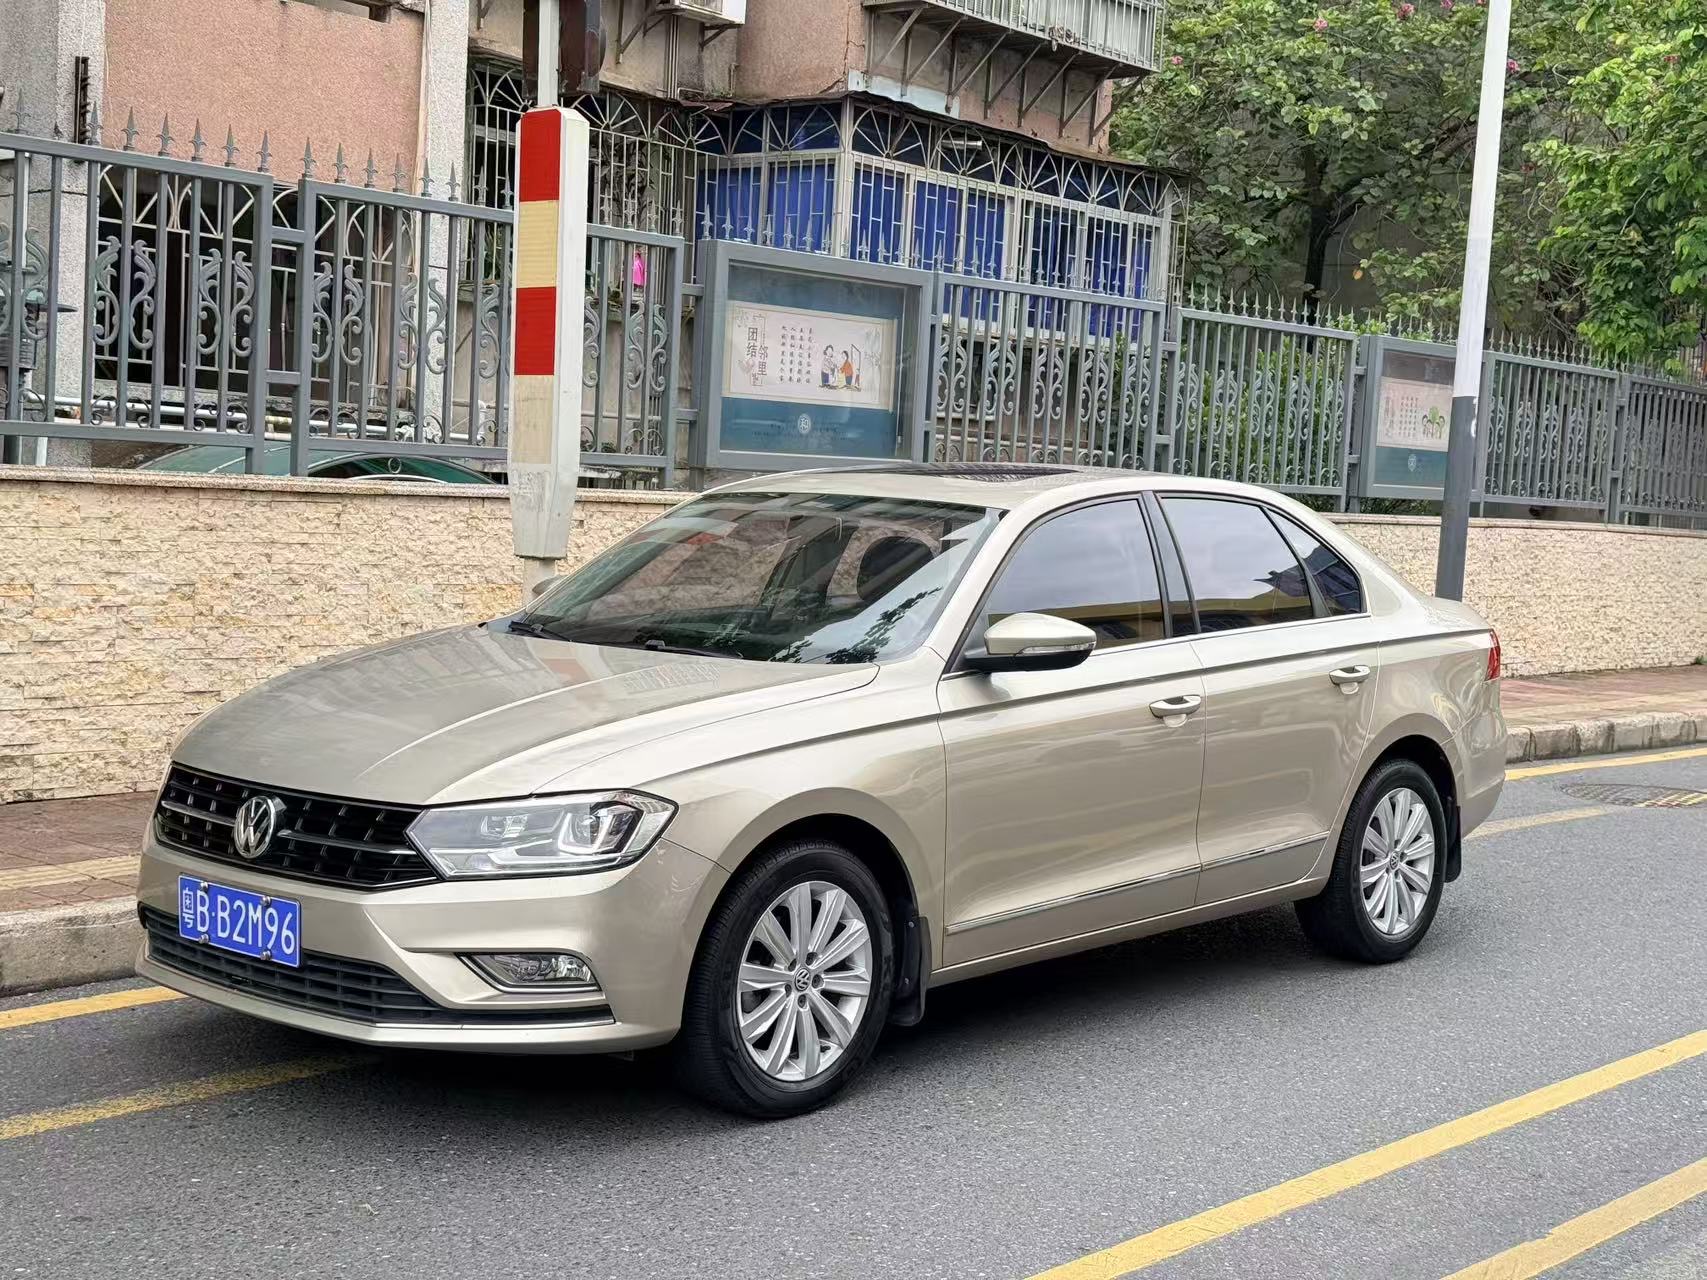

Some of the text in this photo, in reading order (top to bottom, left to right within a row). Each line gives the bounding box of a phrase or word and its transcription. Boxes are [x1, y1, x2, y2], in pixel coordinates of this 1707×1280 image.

[746, 326, 758, 358] 团结
[757, 344, 769, 376] 邻里
[182, 887, 296, 955] 粤B·B2M96
